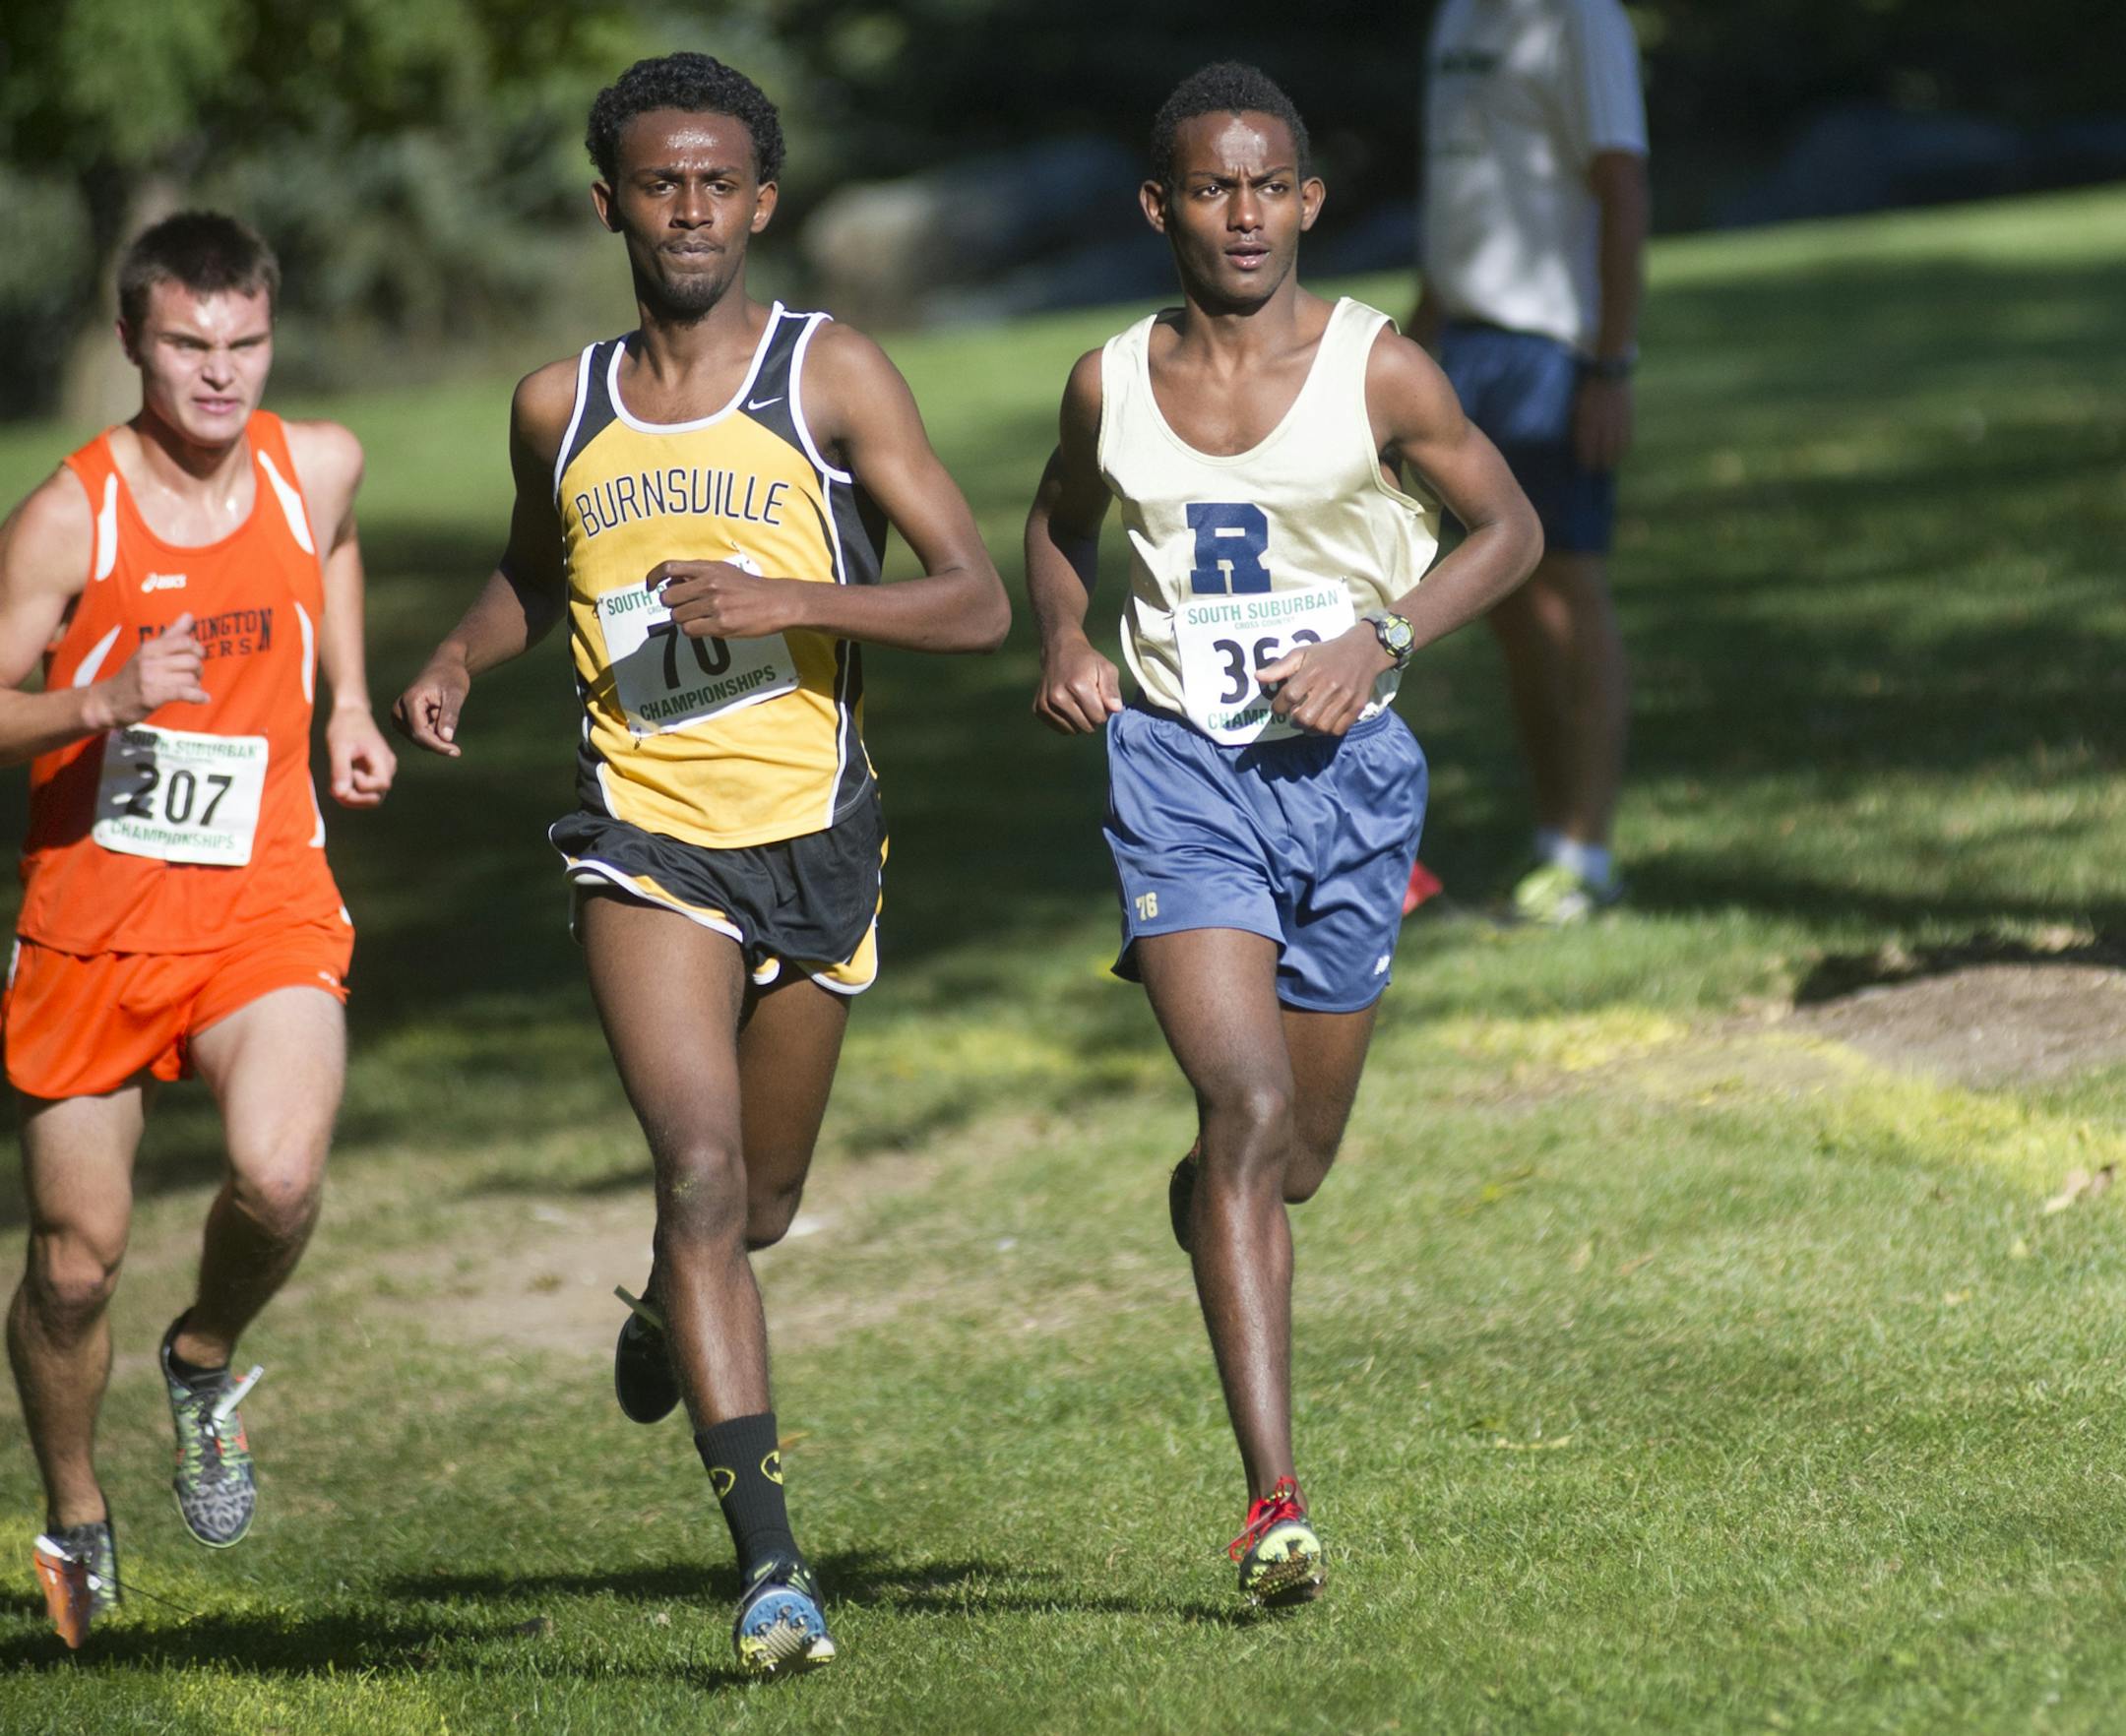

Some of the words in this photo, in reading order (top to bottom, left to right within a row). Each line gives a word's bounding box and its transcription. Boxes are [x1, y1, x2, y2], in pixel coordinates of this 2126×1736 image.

[576, 468, 789, 537] BURNSVILLE
[1186, 503, 1272, 594] R
[606, 591, 653, 616] SOUTH
[1187, 604, 1242, 626] SOUTH
[1246, 589, 1340, 618] SUBURBAN
[647, 619, 731, 690] 70
[640, 664, 777, 721] CHAMPIONSHIPS
[125, 761, 233, 827] 207
[110, 821, 236, 850] CHAMPIONSHIPS
[1135, 892, 1158, 921] 76
